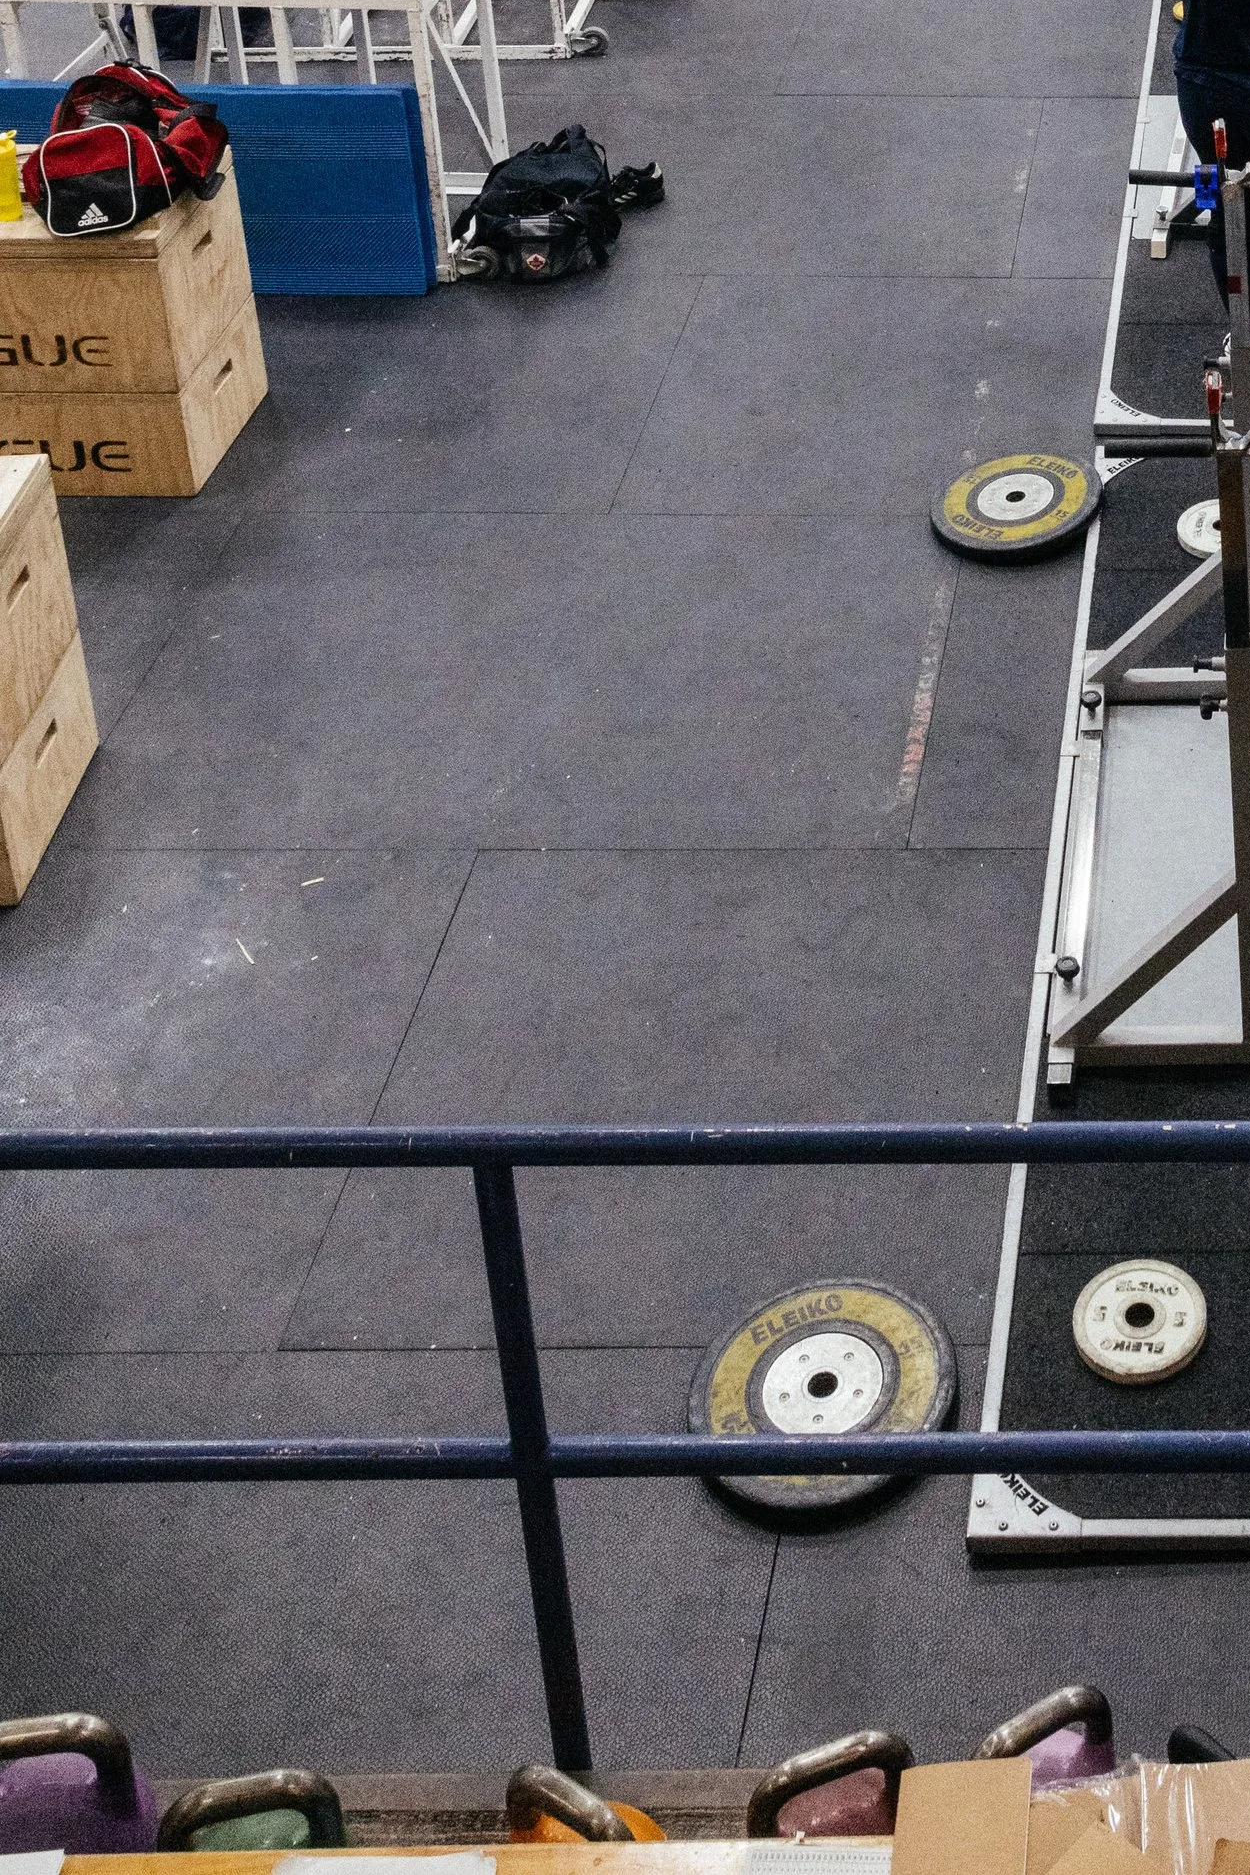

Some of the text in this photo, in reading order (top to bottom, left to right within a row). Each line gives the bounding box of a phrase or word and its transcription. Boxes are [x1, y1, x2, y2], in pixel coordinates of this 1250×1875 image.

[77, 215, 109, 227] adidas
[1111, 398, 1142, 418] ELEIKO
[1026, 456, 1079, 480] ELEIKO
[1106, 457, 1140, 476] ELEIK
[951, 513, 1004, 540] ELEIKO
[1115, 1280, 1180, 1297] ELEIKO
[750, 1293, 844, 1347] ELEIKO
[1100, 1336, 1166, 1355] ELEIKO
